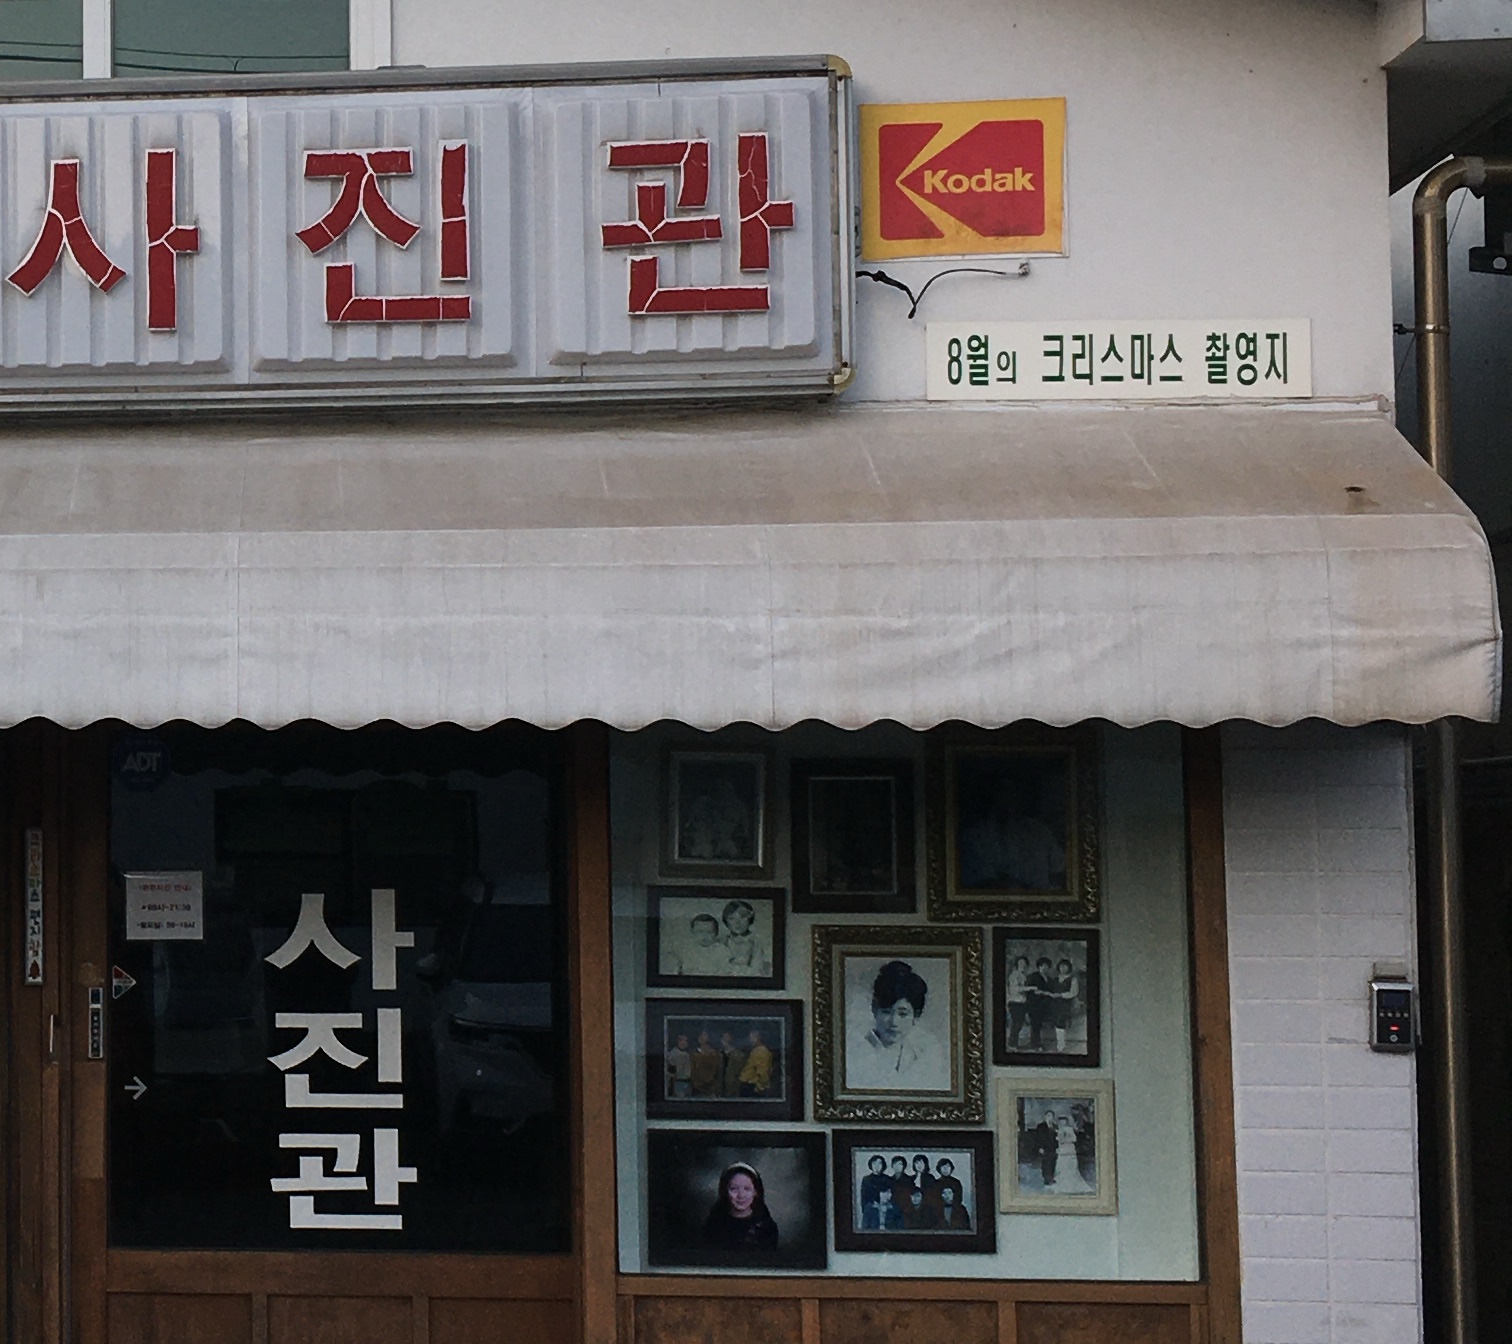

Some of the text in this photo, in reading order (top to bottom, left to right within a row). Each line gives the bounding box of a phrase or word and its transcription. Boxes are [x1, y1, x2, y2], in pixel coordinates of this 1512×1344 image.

[924, 166, 1035, 195] Kodak
[947, 331, 1289, 386] 8월의 크리스마스 촬영지
[121, 752, 162, 772] ADT
[264, 888, 418, 1229] 사진관
